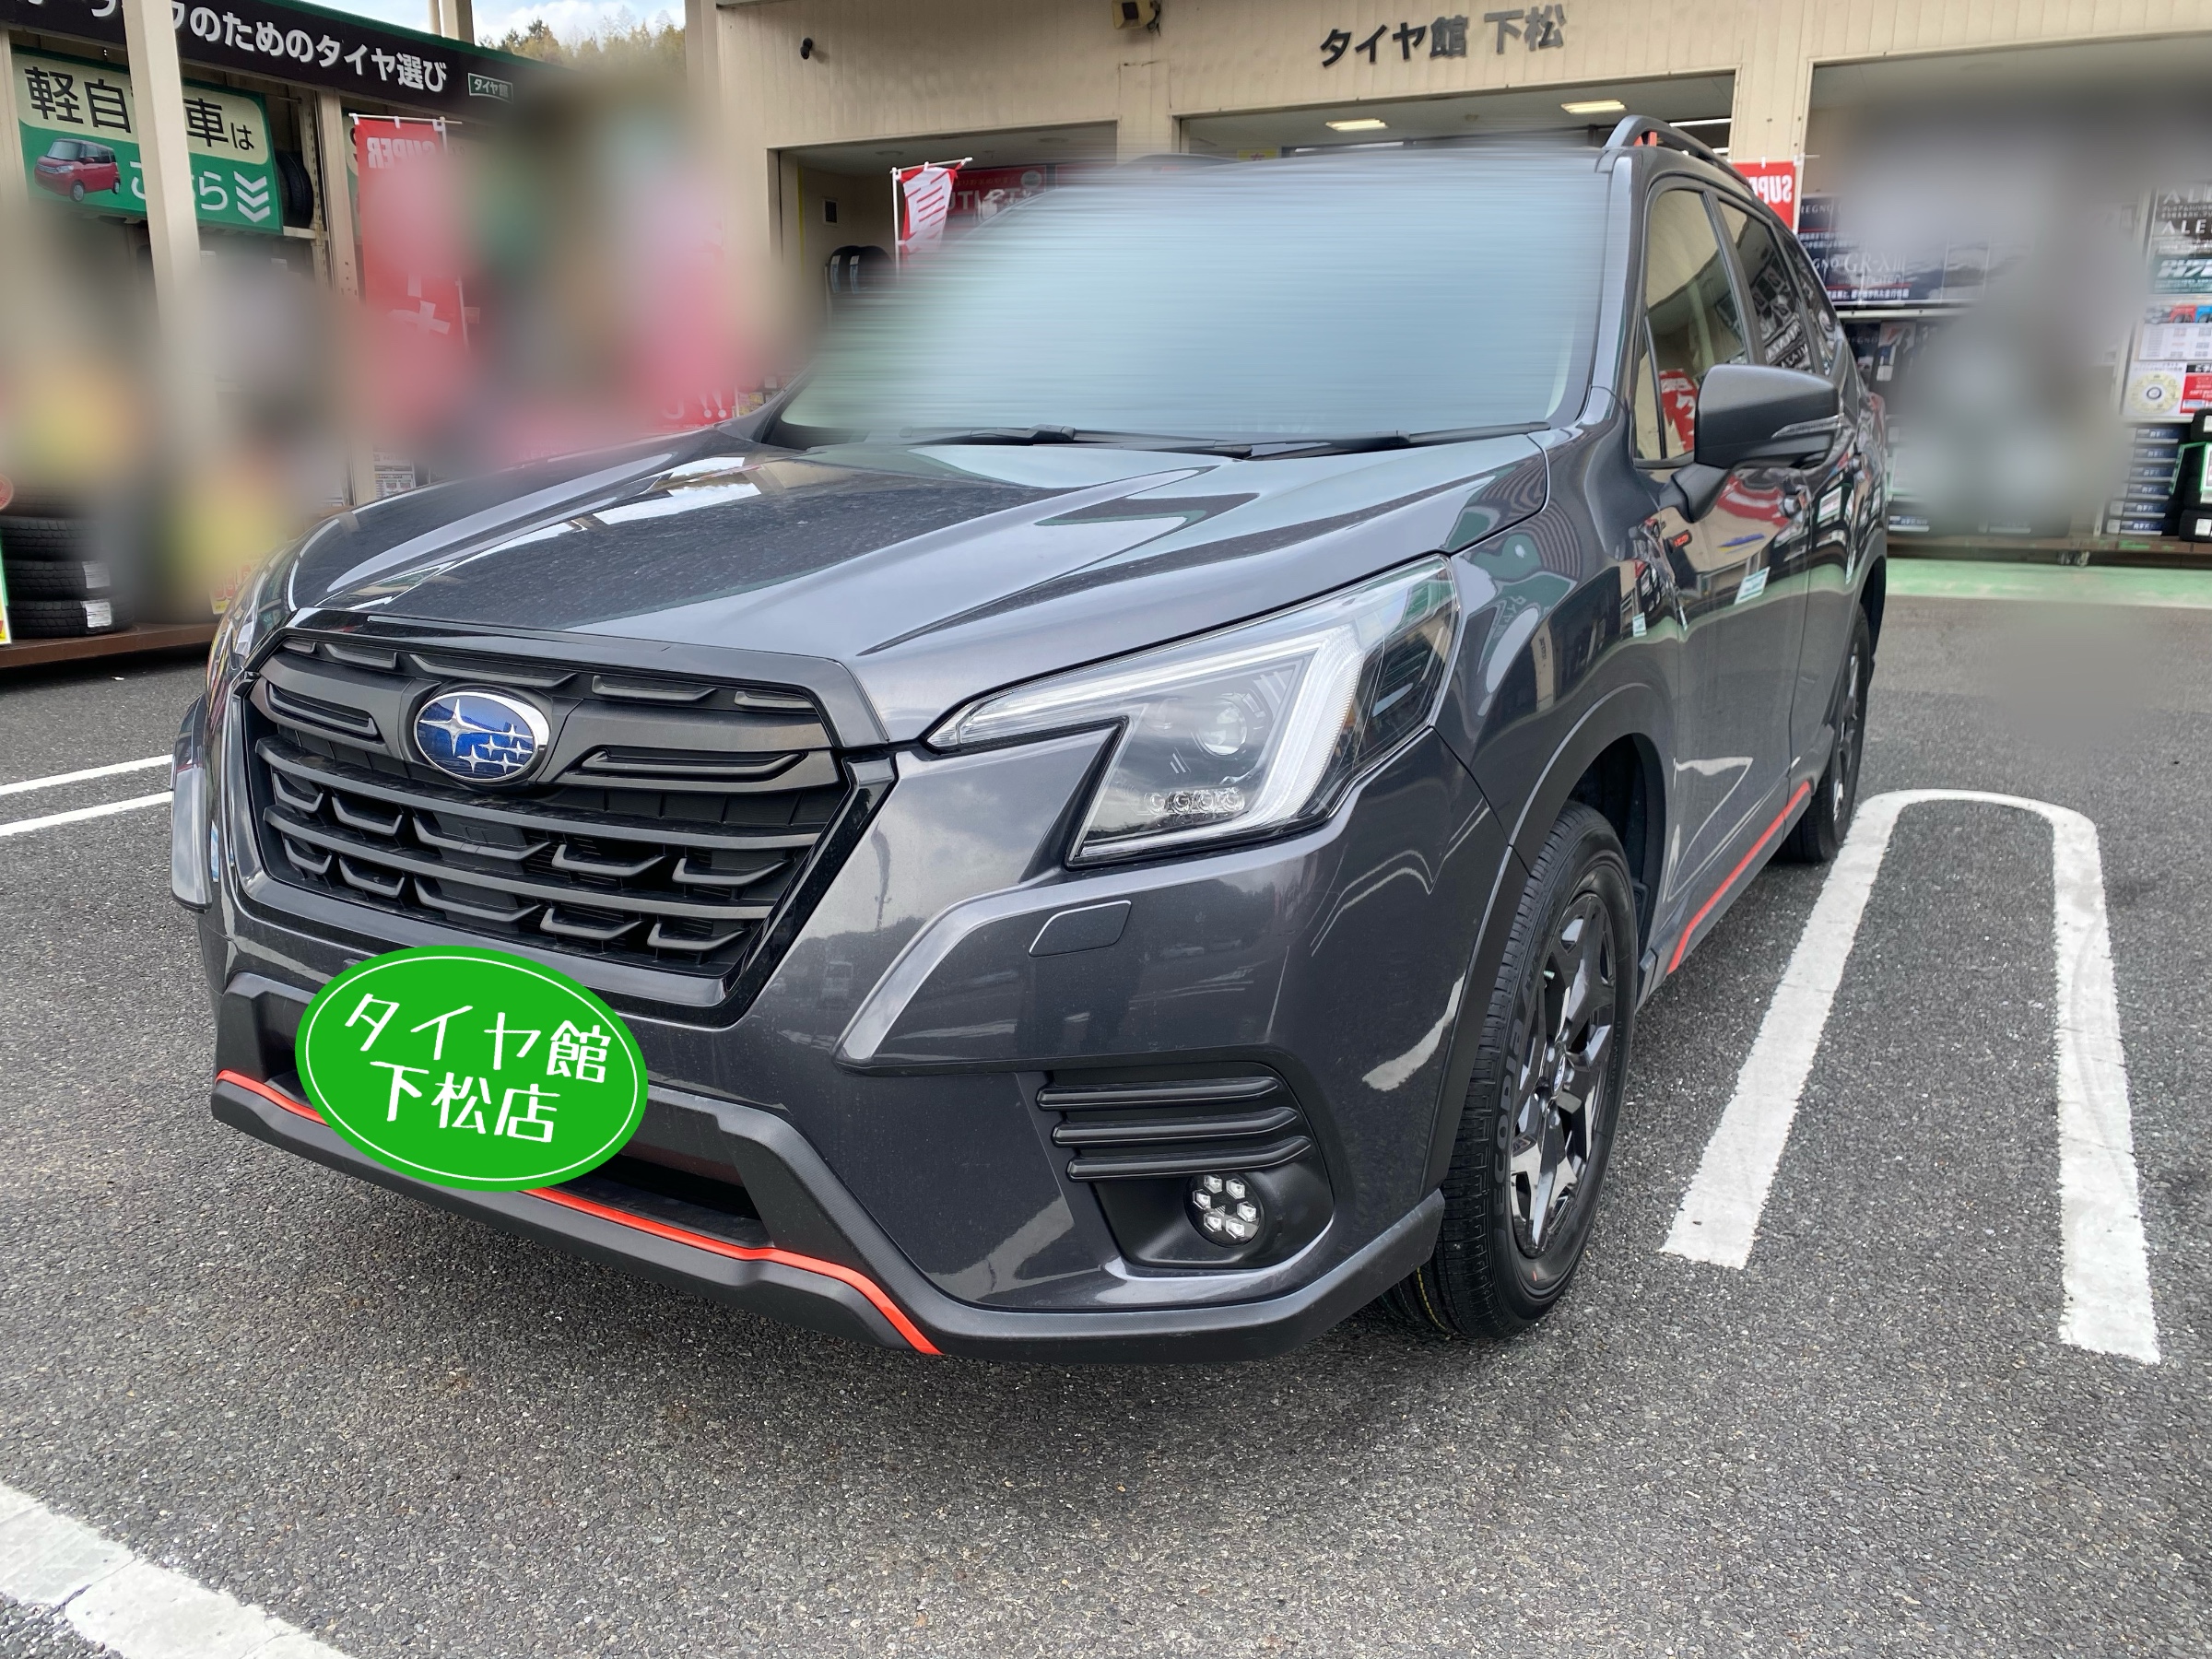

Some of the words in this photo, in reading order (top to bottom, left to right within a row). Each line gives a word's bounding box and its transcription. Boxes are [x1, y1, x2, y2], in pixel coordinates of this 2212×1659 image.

[1320, 15, 1469, 68] タイヤ館
[1484, 3, 1567, 55] 下松
[24, 66, 255, 151] 軽自車は
